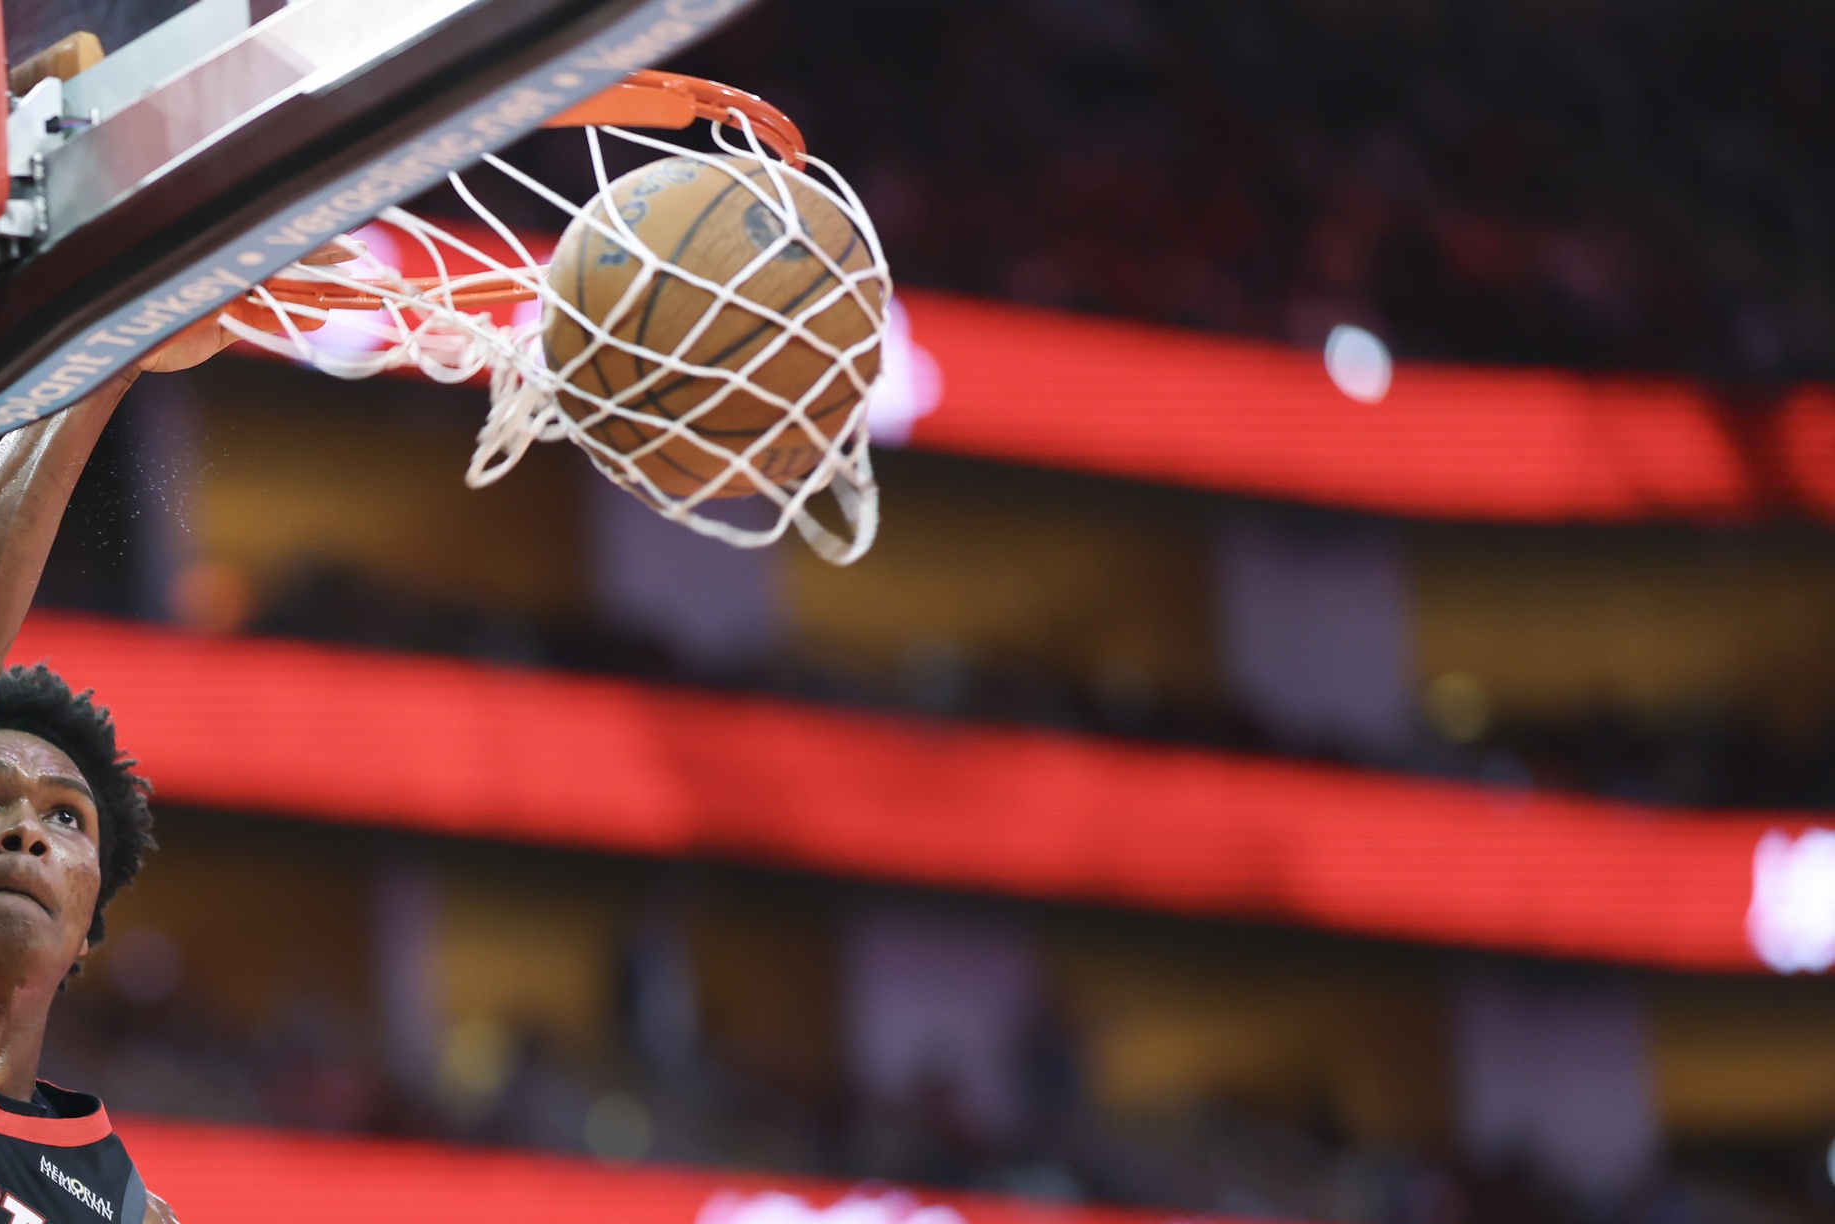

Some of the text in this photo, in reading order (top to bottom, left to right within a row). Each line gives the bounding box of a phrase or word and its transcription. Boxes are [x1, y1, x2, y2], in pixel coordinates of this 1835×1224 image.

[84, 267, 251, 347] Turkey
[40, 1155, 111, 1212] MEMORIAL
[40, 1166, 114, 1221] HERMANN
